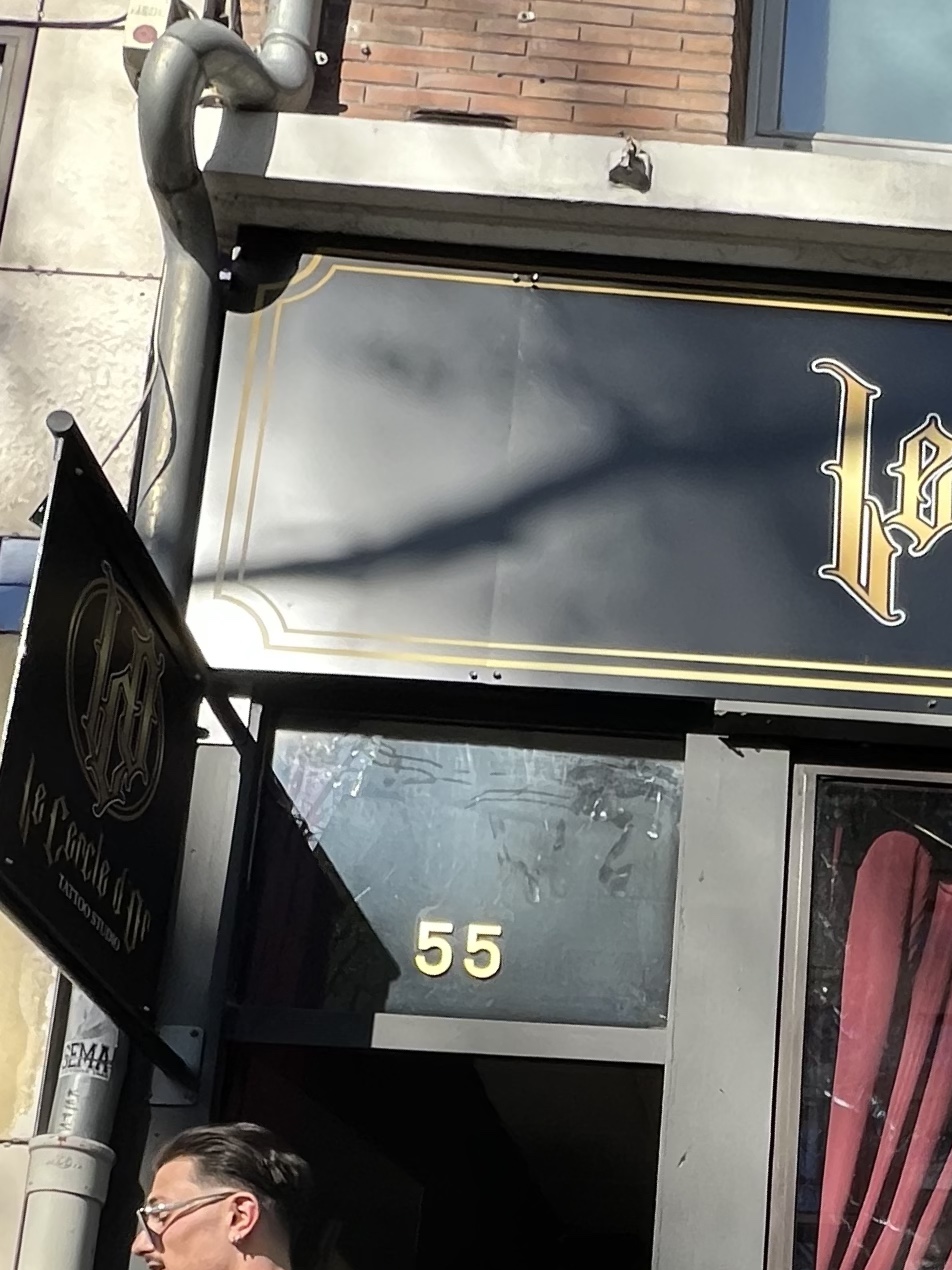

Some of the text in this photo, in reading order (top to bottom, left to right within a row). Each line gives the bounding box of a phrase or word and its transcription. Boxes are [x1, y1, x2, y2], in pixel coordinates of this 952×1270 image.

[43, 795, 111, 897] Cercle
[58, 871, 121, 952] TATTOO STUDIO
[415, 920, 503, 980] 55
